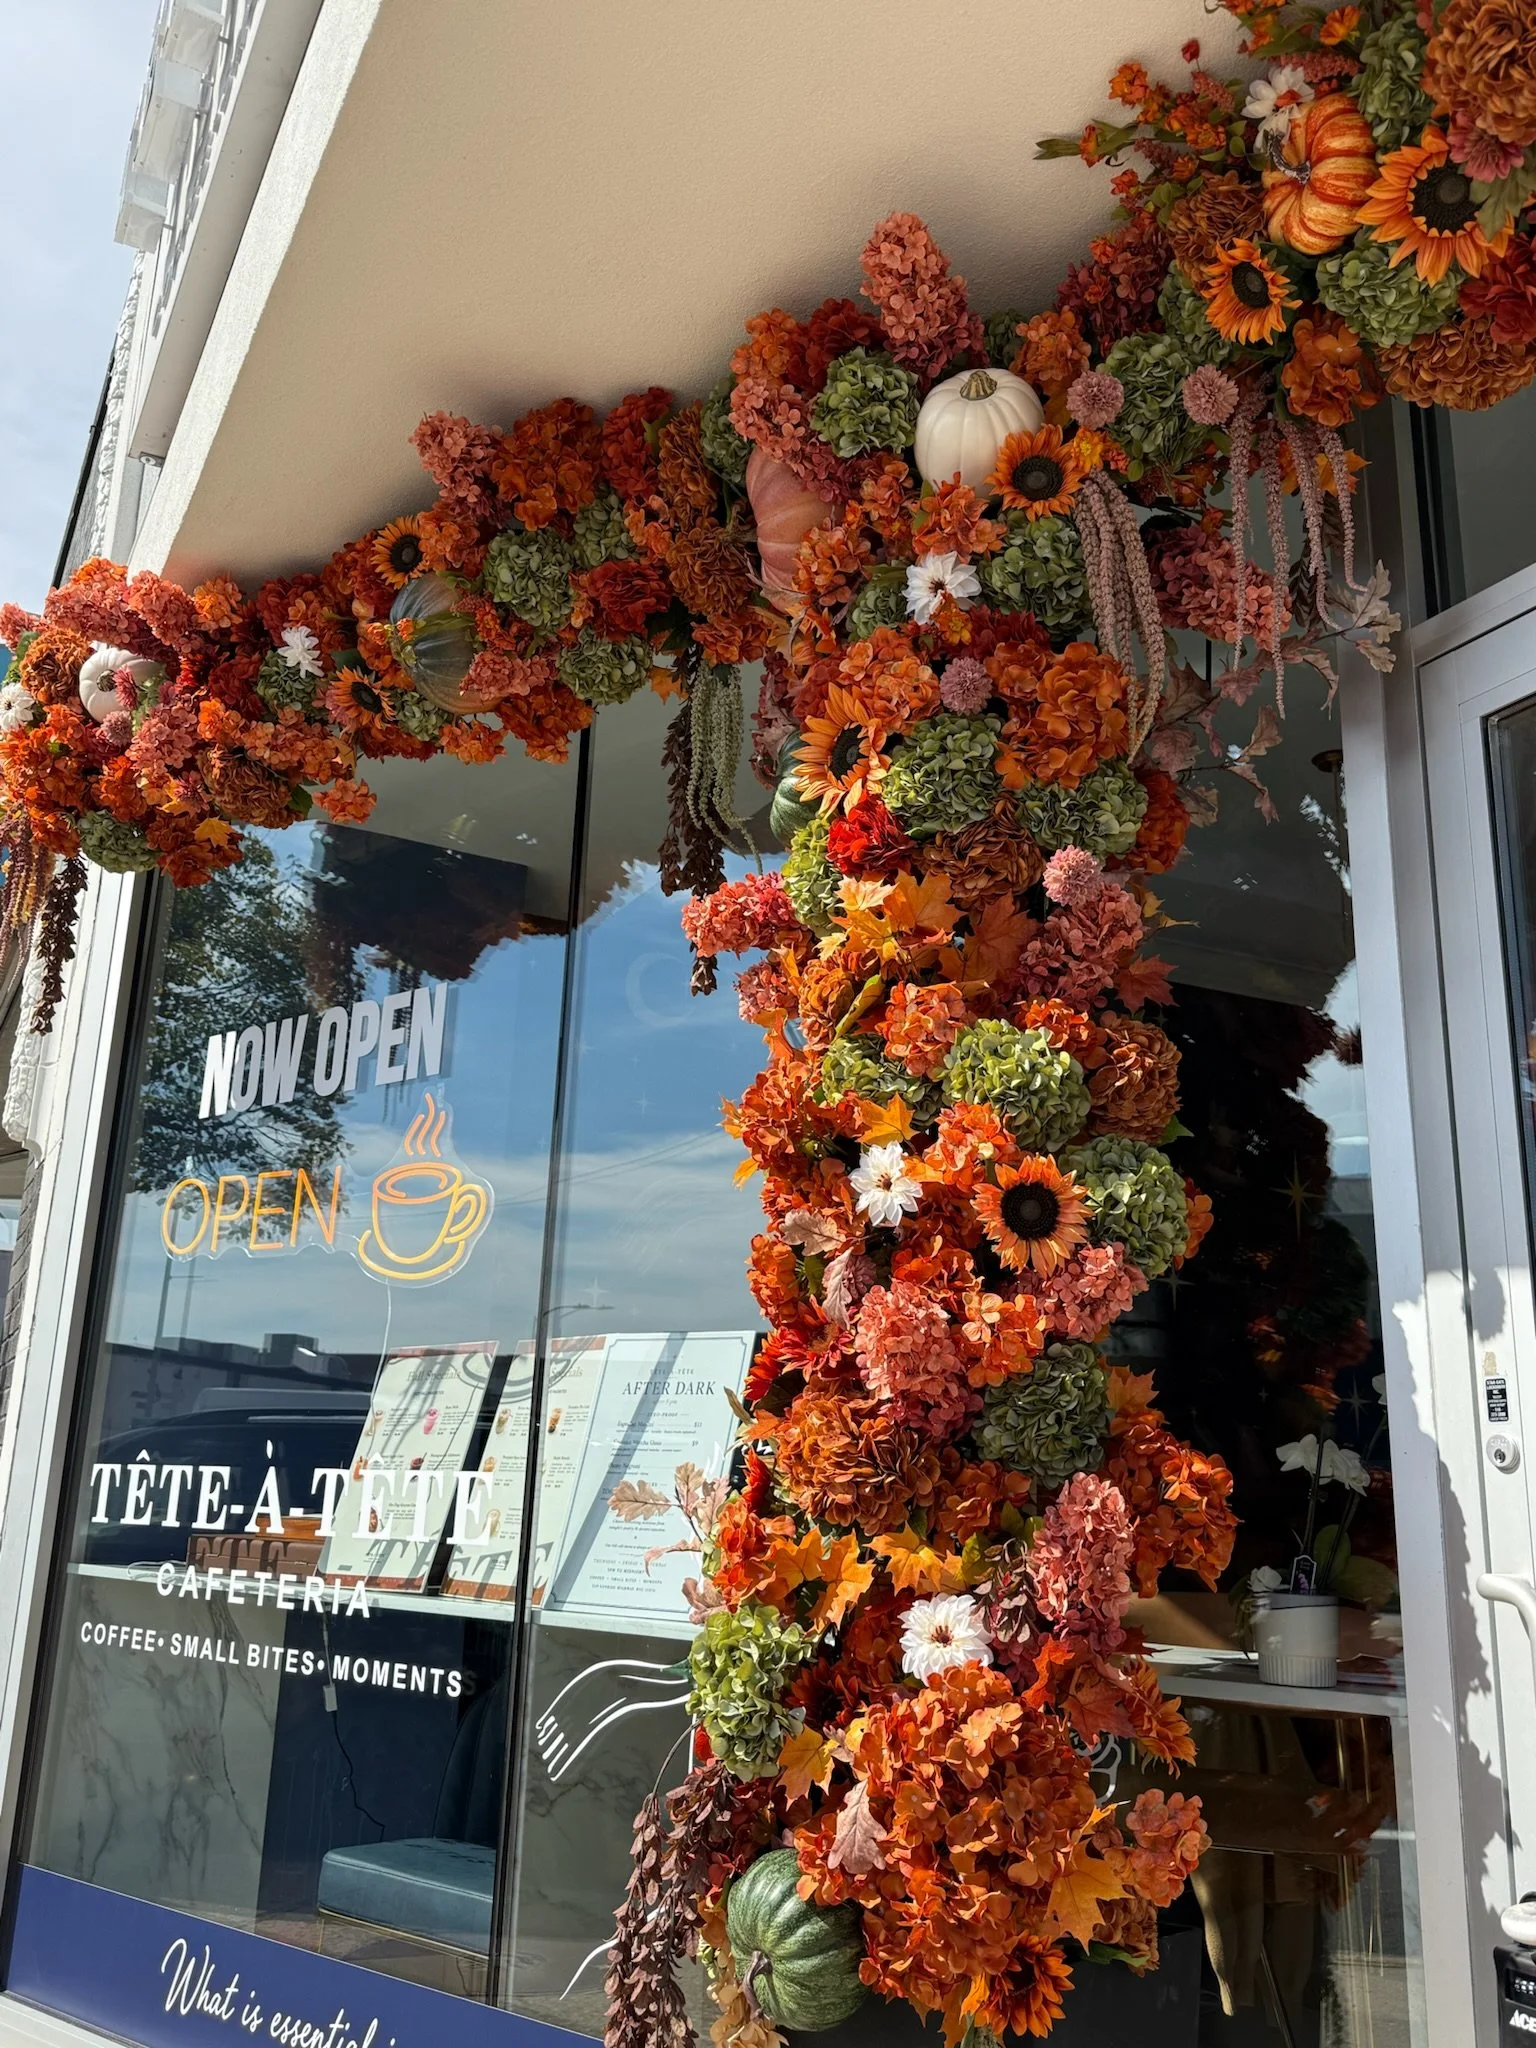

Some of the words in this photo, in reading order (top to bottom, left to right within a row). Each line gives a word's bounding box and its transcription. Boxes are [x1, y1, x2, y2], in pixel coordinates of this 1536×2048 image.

[199, 1013, 309, 1119] NOW
[313, 982, 448, 1097] OPEN
[162, 1165, 342, 1254] OPEN
[622, 1381, 670, 1395] AFTER
[675, 1381, 716, 1395] DARK
[90, 1439, 496, 1545] TÊTE-À-TÊTE
[156, 1562, 371, 1618] CAFETERIA
[169, 1633, 240, 1665] SMALL
[332, 1655, 463, 1698] MOMENTS
[160, 1938, 240, 2020] What
[241, 1990, 263, 2033] is
